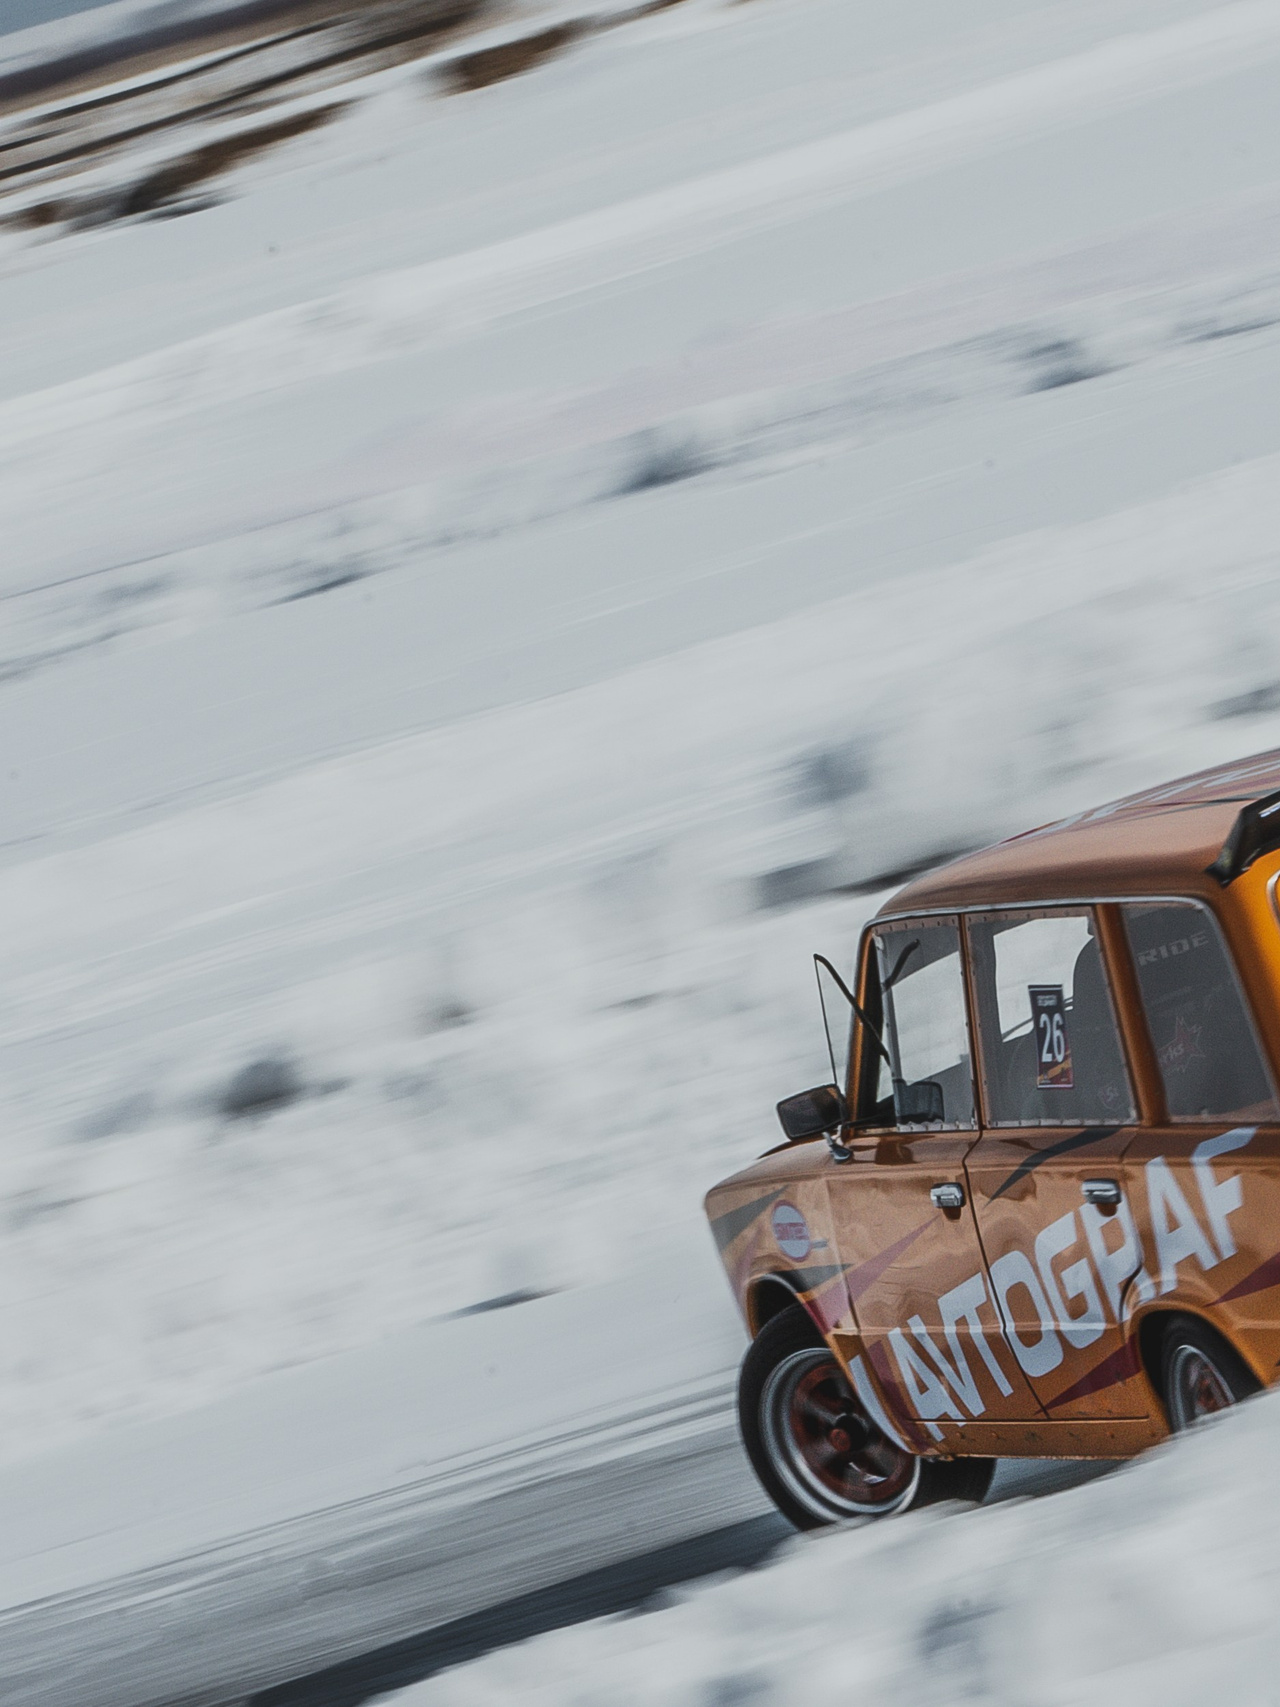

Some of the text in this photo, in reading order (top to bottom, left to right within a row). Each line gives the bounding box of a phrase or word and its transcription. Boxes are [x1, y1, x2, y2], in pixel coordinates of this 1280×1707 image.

[1137, 930, 1209, 966] RIDE
[1039, 1013, 1065, 1062] 26
[887, 1126, 1259, 1442] AVTOGRAF
